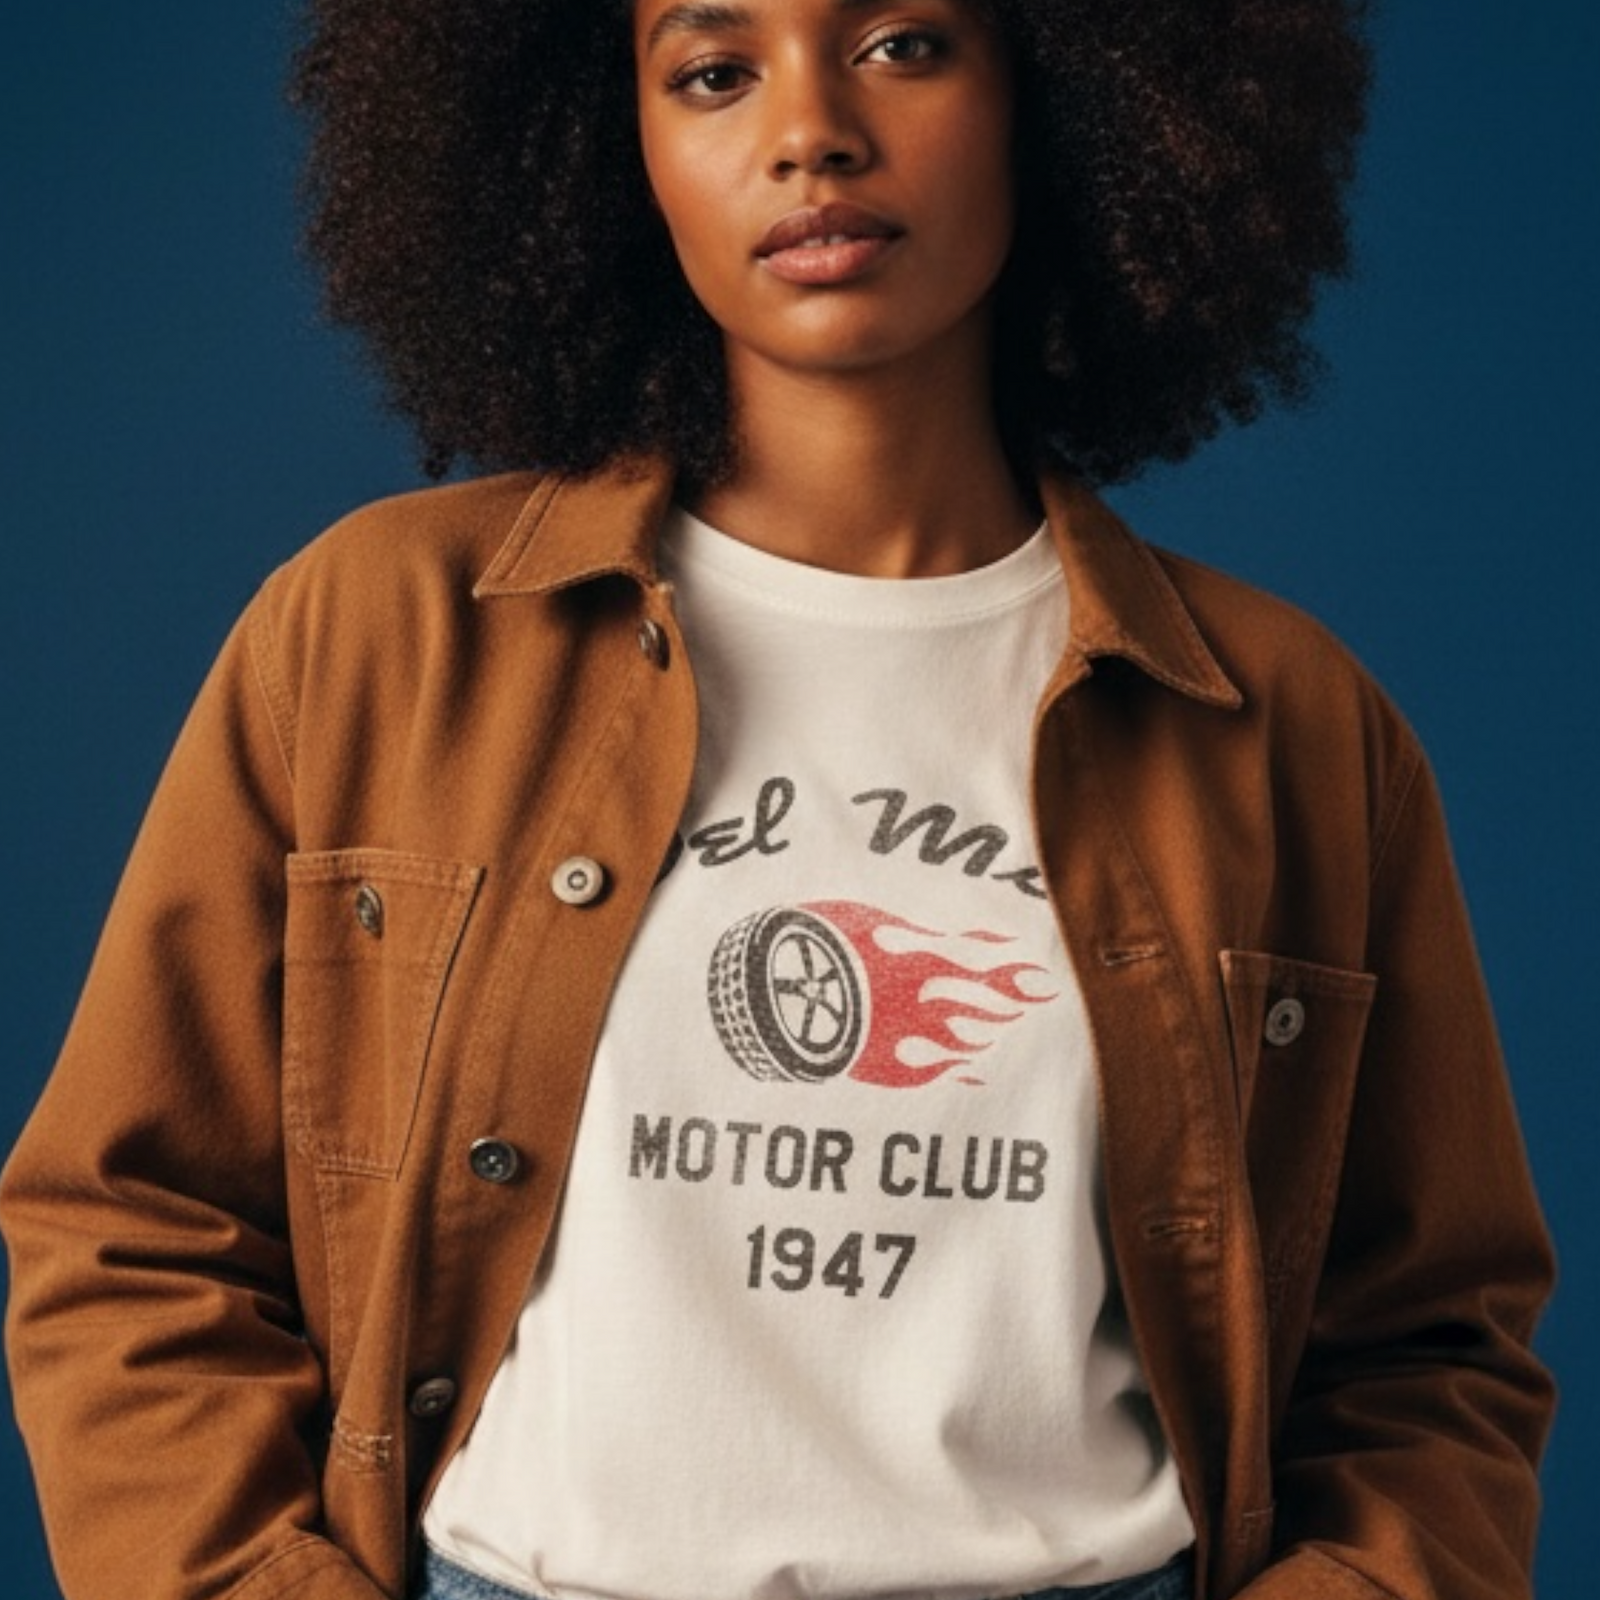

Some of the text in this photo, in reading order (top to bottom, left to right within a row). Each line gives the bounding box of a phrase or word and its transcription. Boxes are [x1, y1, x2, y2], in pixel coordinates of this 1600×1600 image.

[628, 1114, 1048, 1203] MOTOR CLUB
[746, 1224, 917, 1299] 1947
